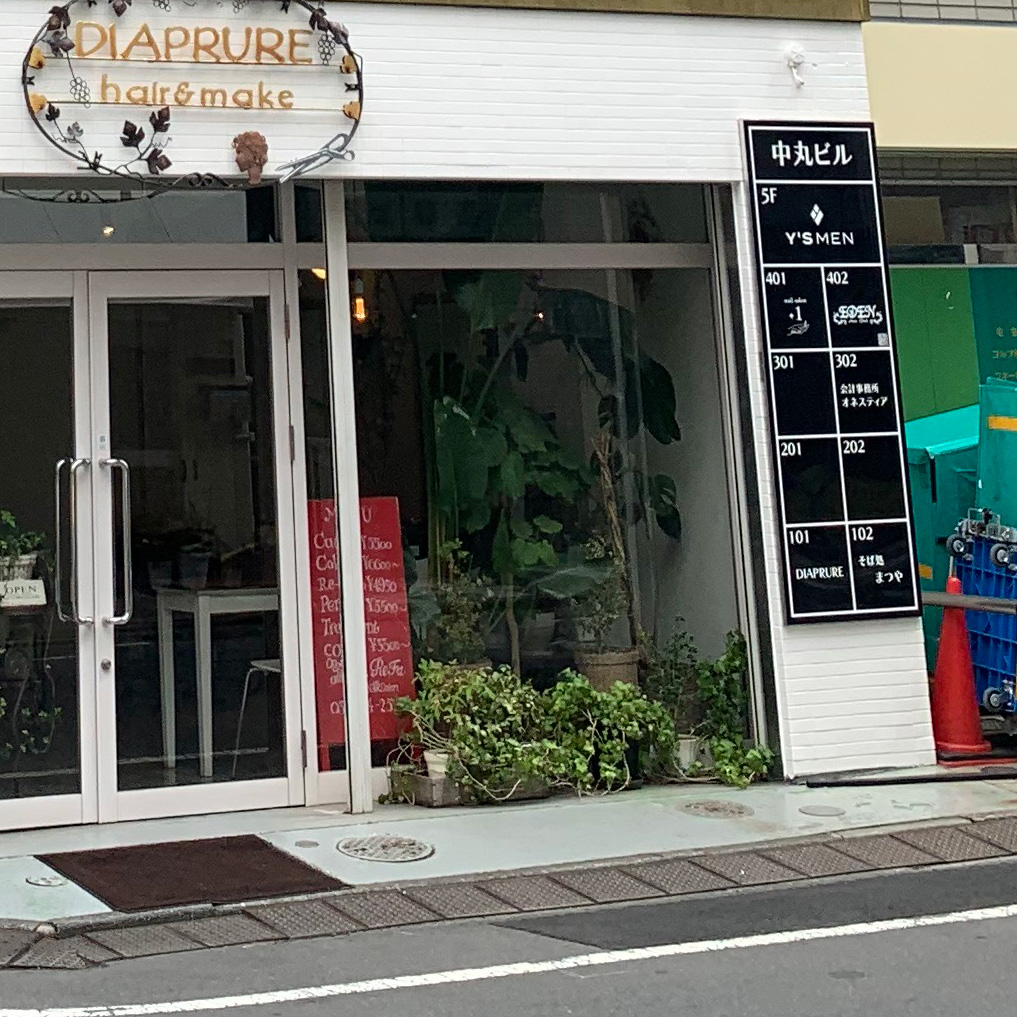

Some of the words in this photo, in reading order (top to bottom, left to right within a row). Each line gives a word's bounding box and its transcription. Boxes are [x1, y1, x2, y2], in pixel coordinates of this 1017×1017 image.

[76, 20, 313, 64] DIAPRURE
[100, 74, 295, 110] hair&make
[771, 139, 853, 167] 中丸ビル
[761, 187, 777, 204] 5F
[766, 271, 786, 285] 401
[826, 271, 849, 285] 402
[773, 355, 794, 370] 301
[835, 353, 858, 368] 302
[840, 382, 879, 395] 会計事務所
[841, 396, 888, 408] オネスティア
[781, 442, 802, 456] 201
[843, 439, 865, 454] 202
[789, 530, 809, 544] 101
[852, 526, 874, 541] 102
[858, 554, 885, 567] そば処
[796, 566, 844, 580] DIAPRURE
[874, 570, 904, 584] まつや
[5, 585, 37, 595] OPEN
